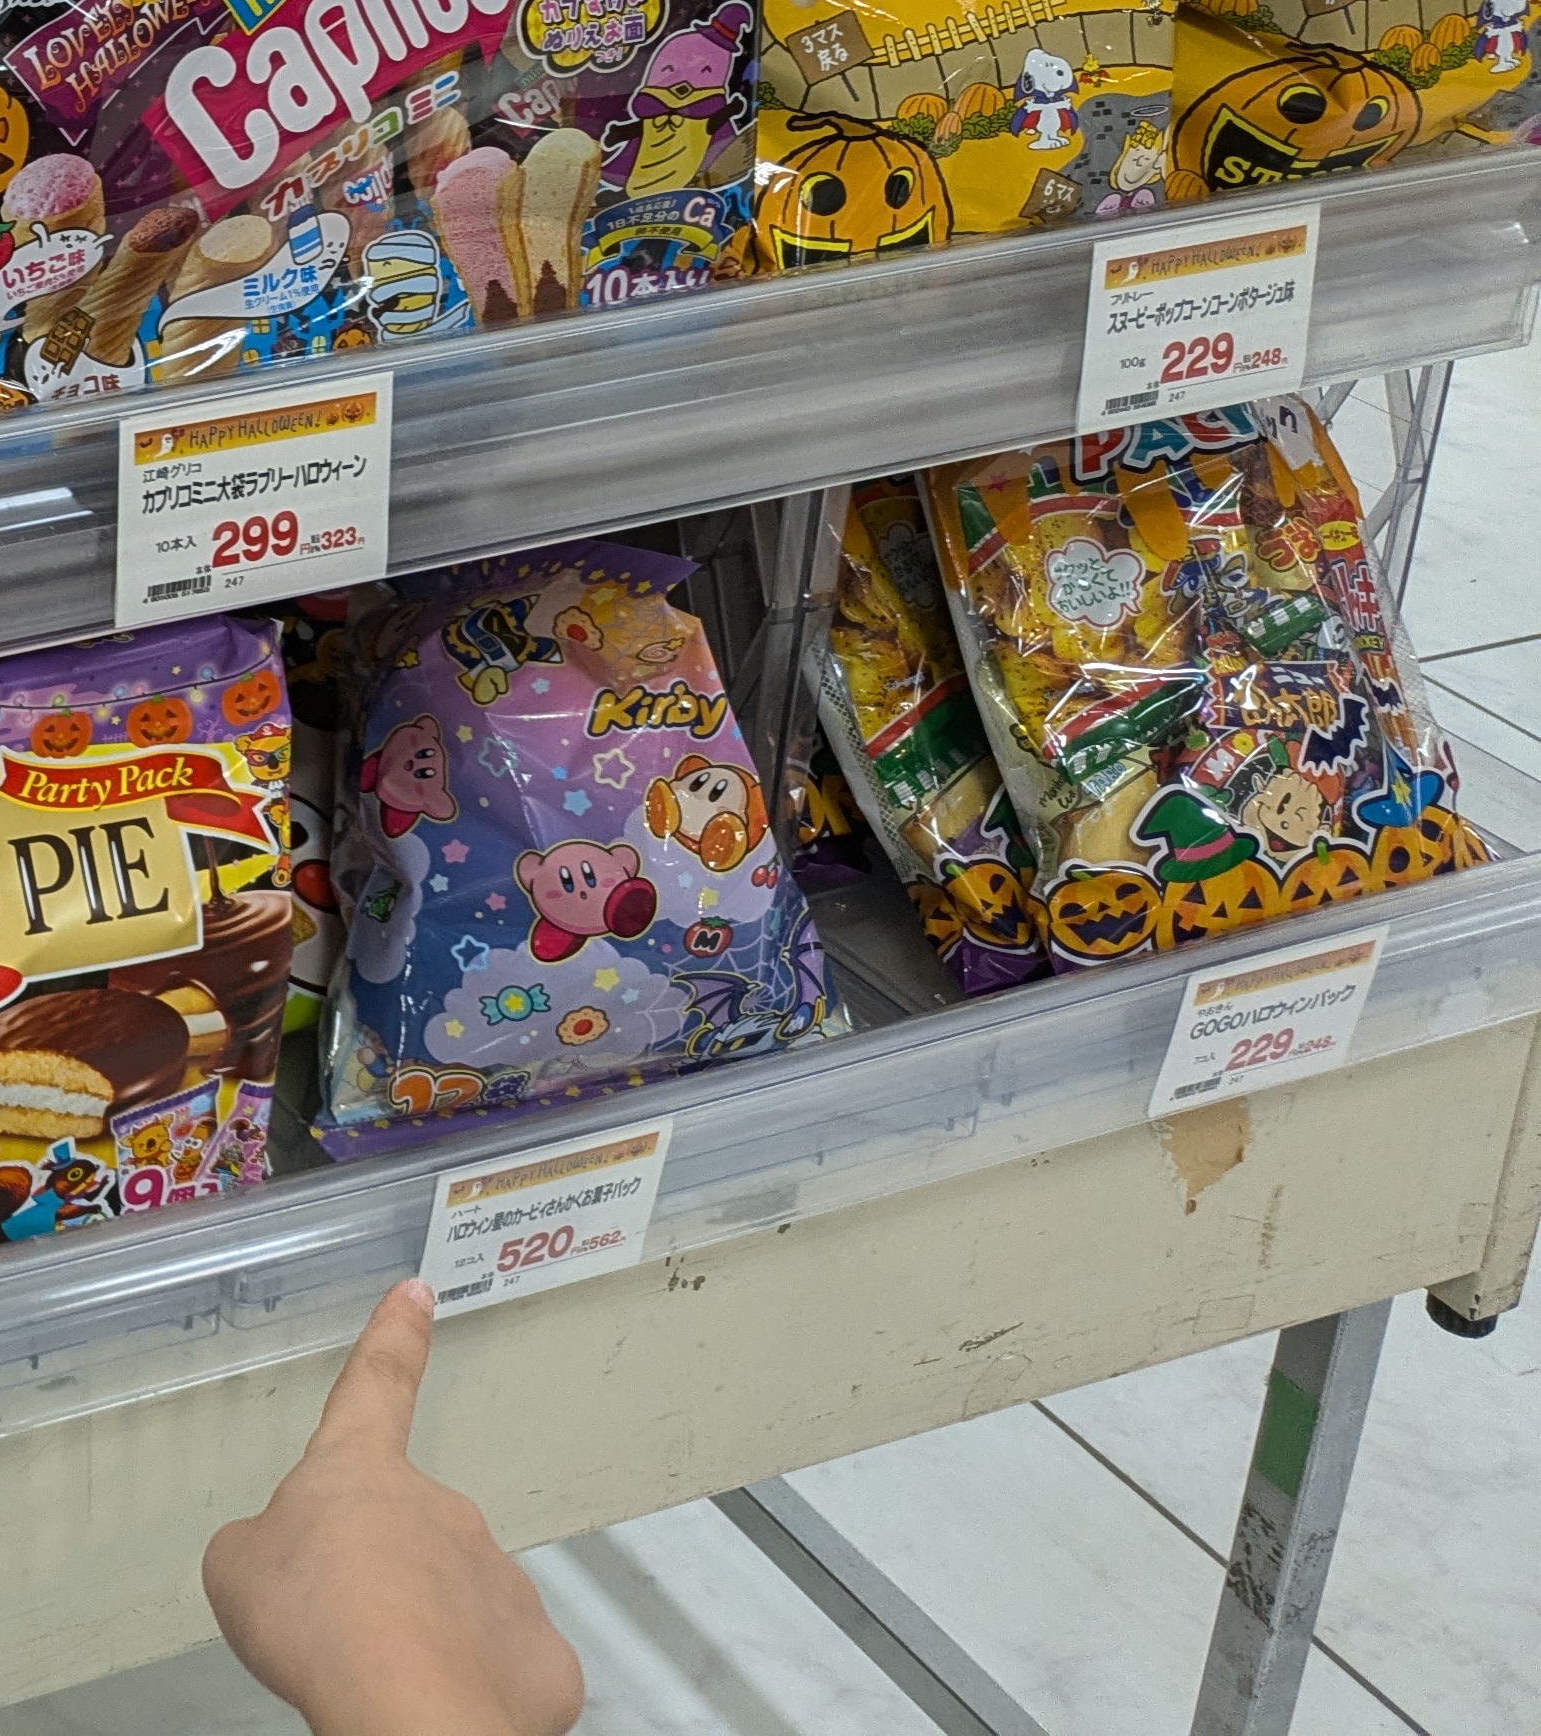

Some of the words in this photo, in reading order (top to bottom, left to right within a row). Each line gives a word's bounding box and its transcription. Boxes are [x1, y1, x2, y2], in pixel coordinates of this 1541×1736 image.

[539, 14, 647, 54] ぬりえお面
[261, 71, 462, 221] カプリコミニ
[683, 196, 716, 228] Ca
[3, 248, 86, 289] いちご味
[243, 265, 319, 298] ミルク味
[143, 463, 201, 483] 江崎グリコ
[156, 536, 197, 553] 10本入
[591, 683, 726, 737] Kirby
[18, 762, 111, 808] Party
[118, 753, 196, 798] Pack
[8, 813, 171, 937] PIE
